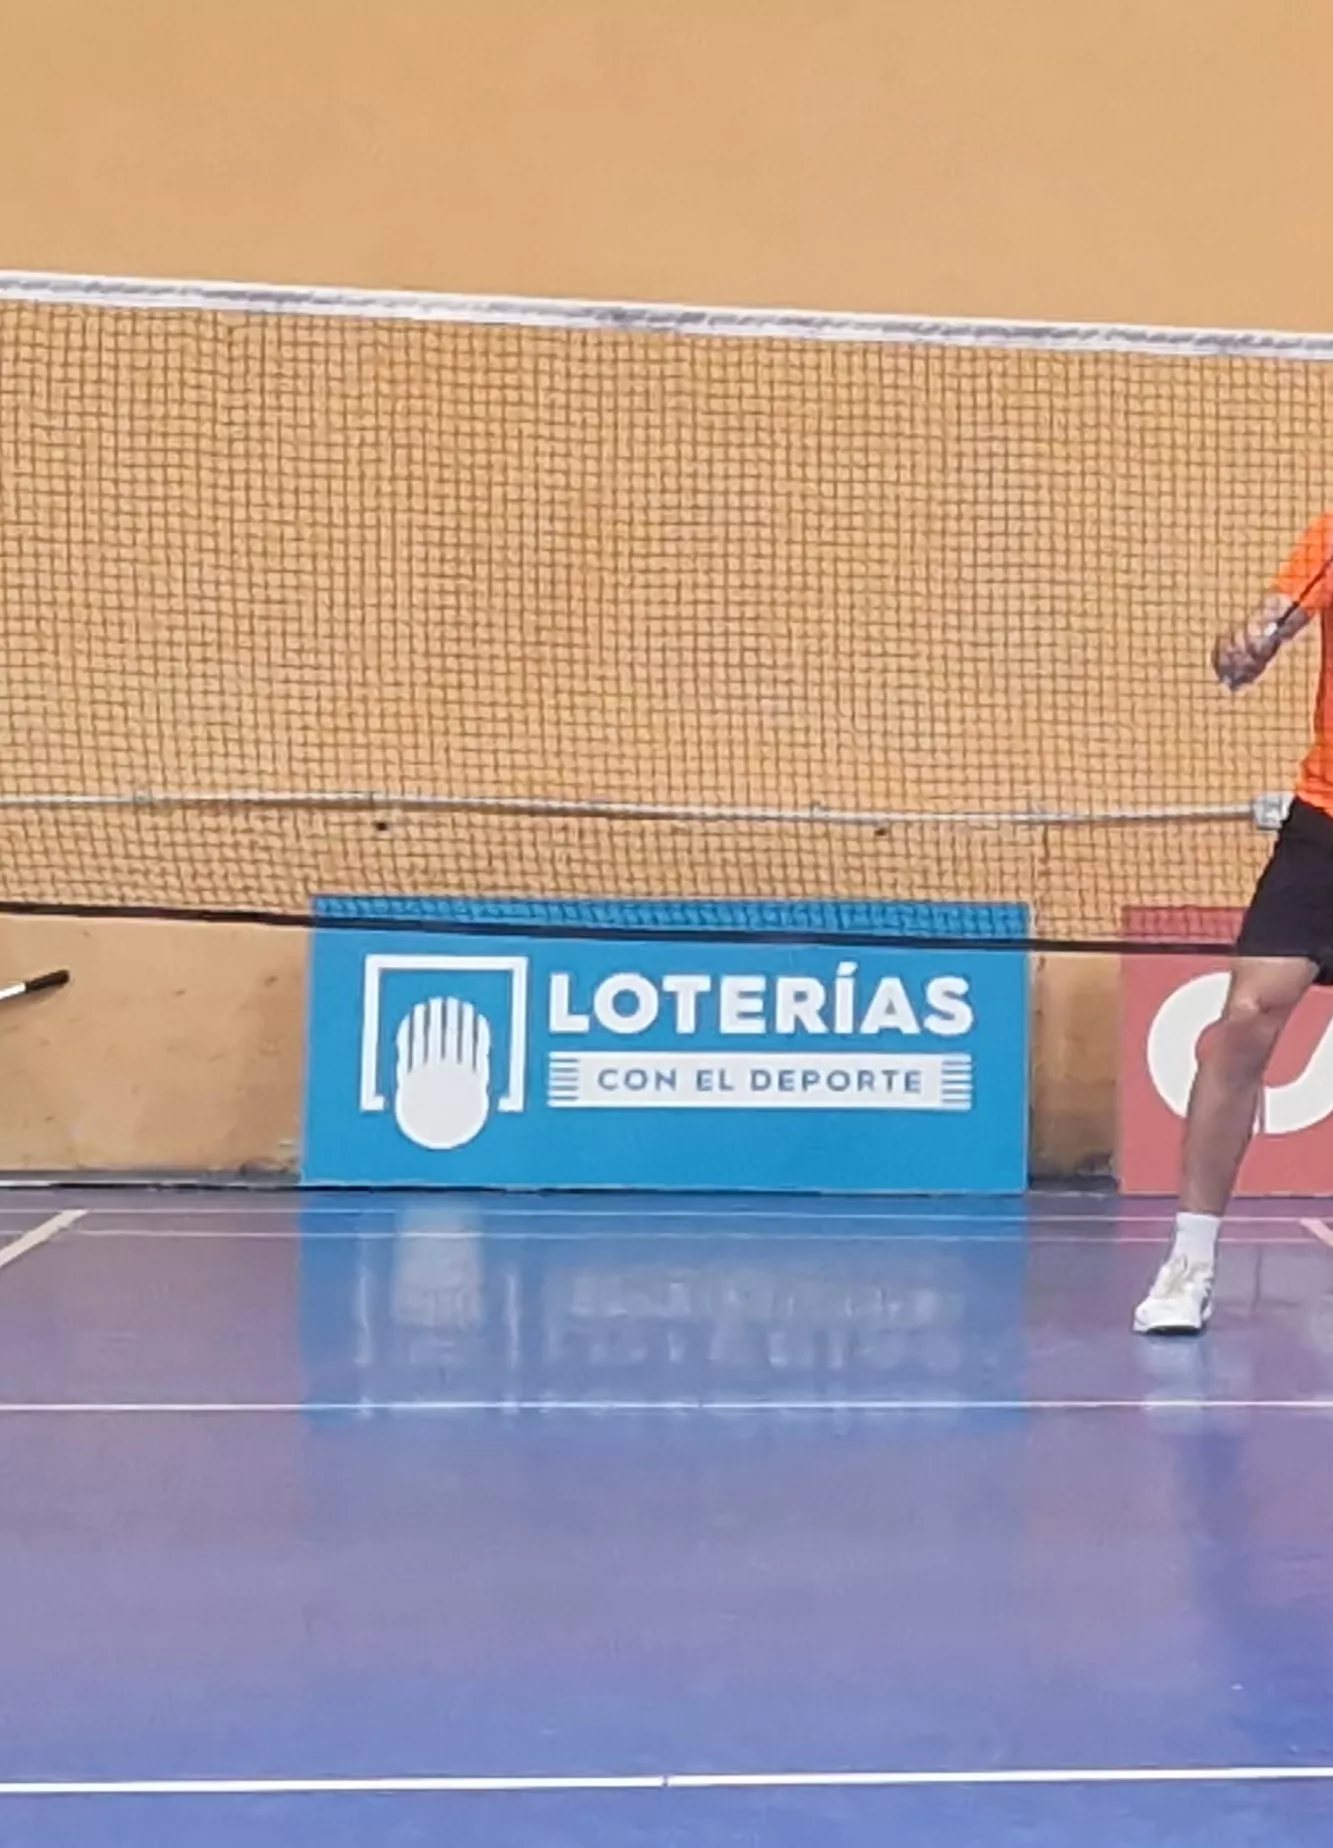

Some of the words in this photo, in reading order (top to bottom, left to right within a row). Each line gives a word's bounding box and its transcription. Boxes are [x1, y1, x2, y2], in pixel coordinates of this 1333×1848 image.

[547, 960, 975, 1037] LOTERÍAS
[598, 1068, 678, 1093] CON
[695, 1068, 735, 1093] EL
[749, 1069, 923, 1095] DEPORTE
